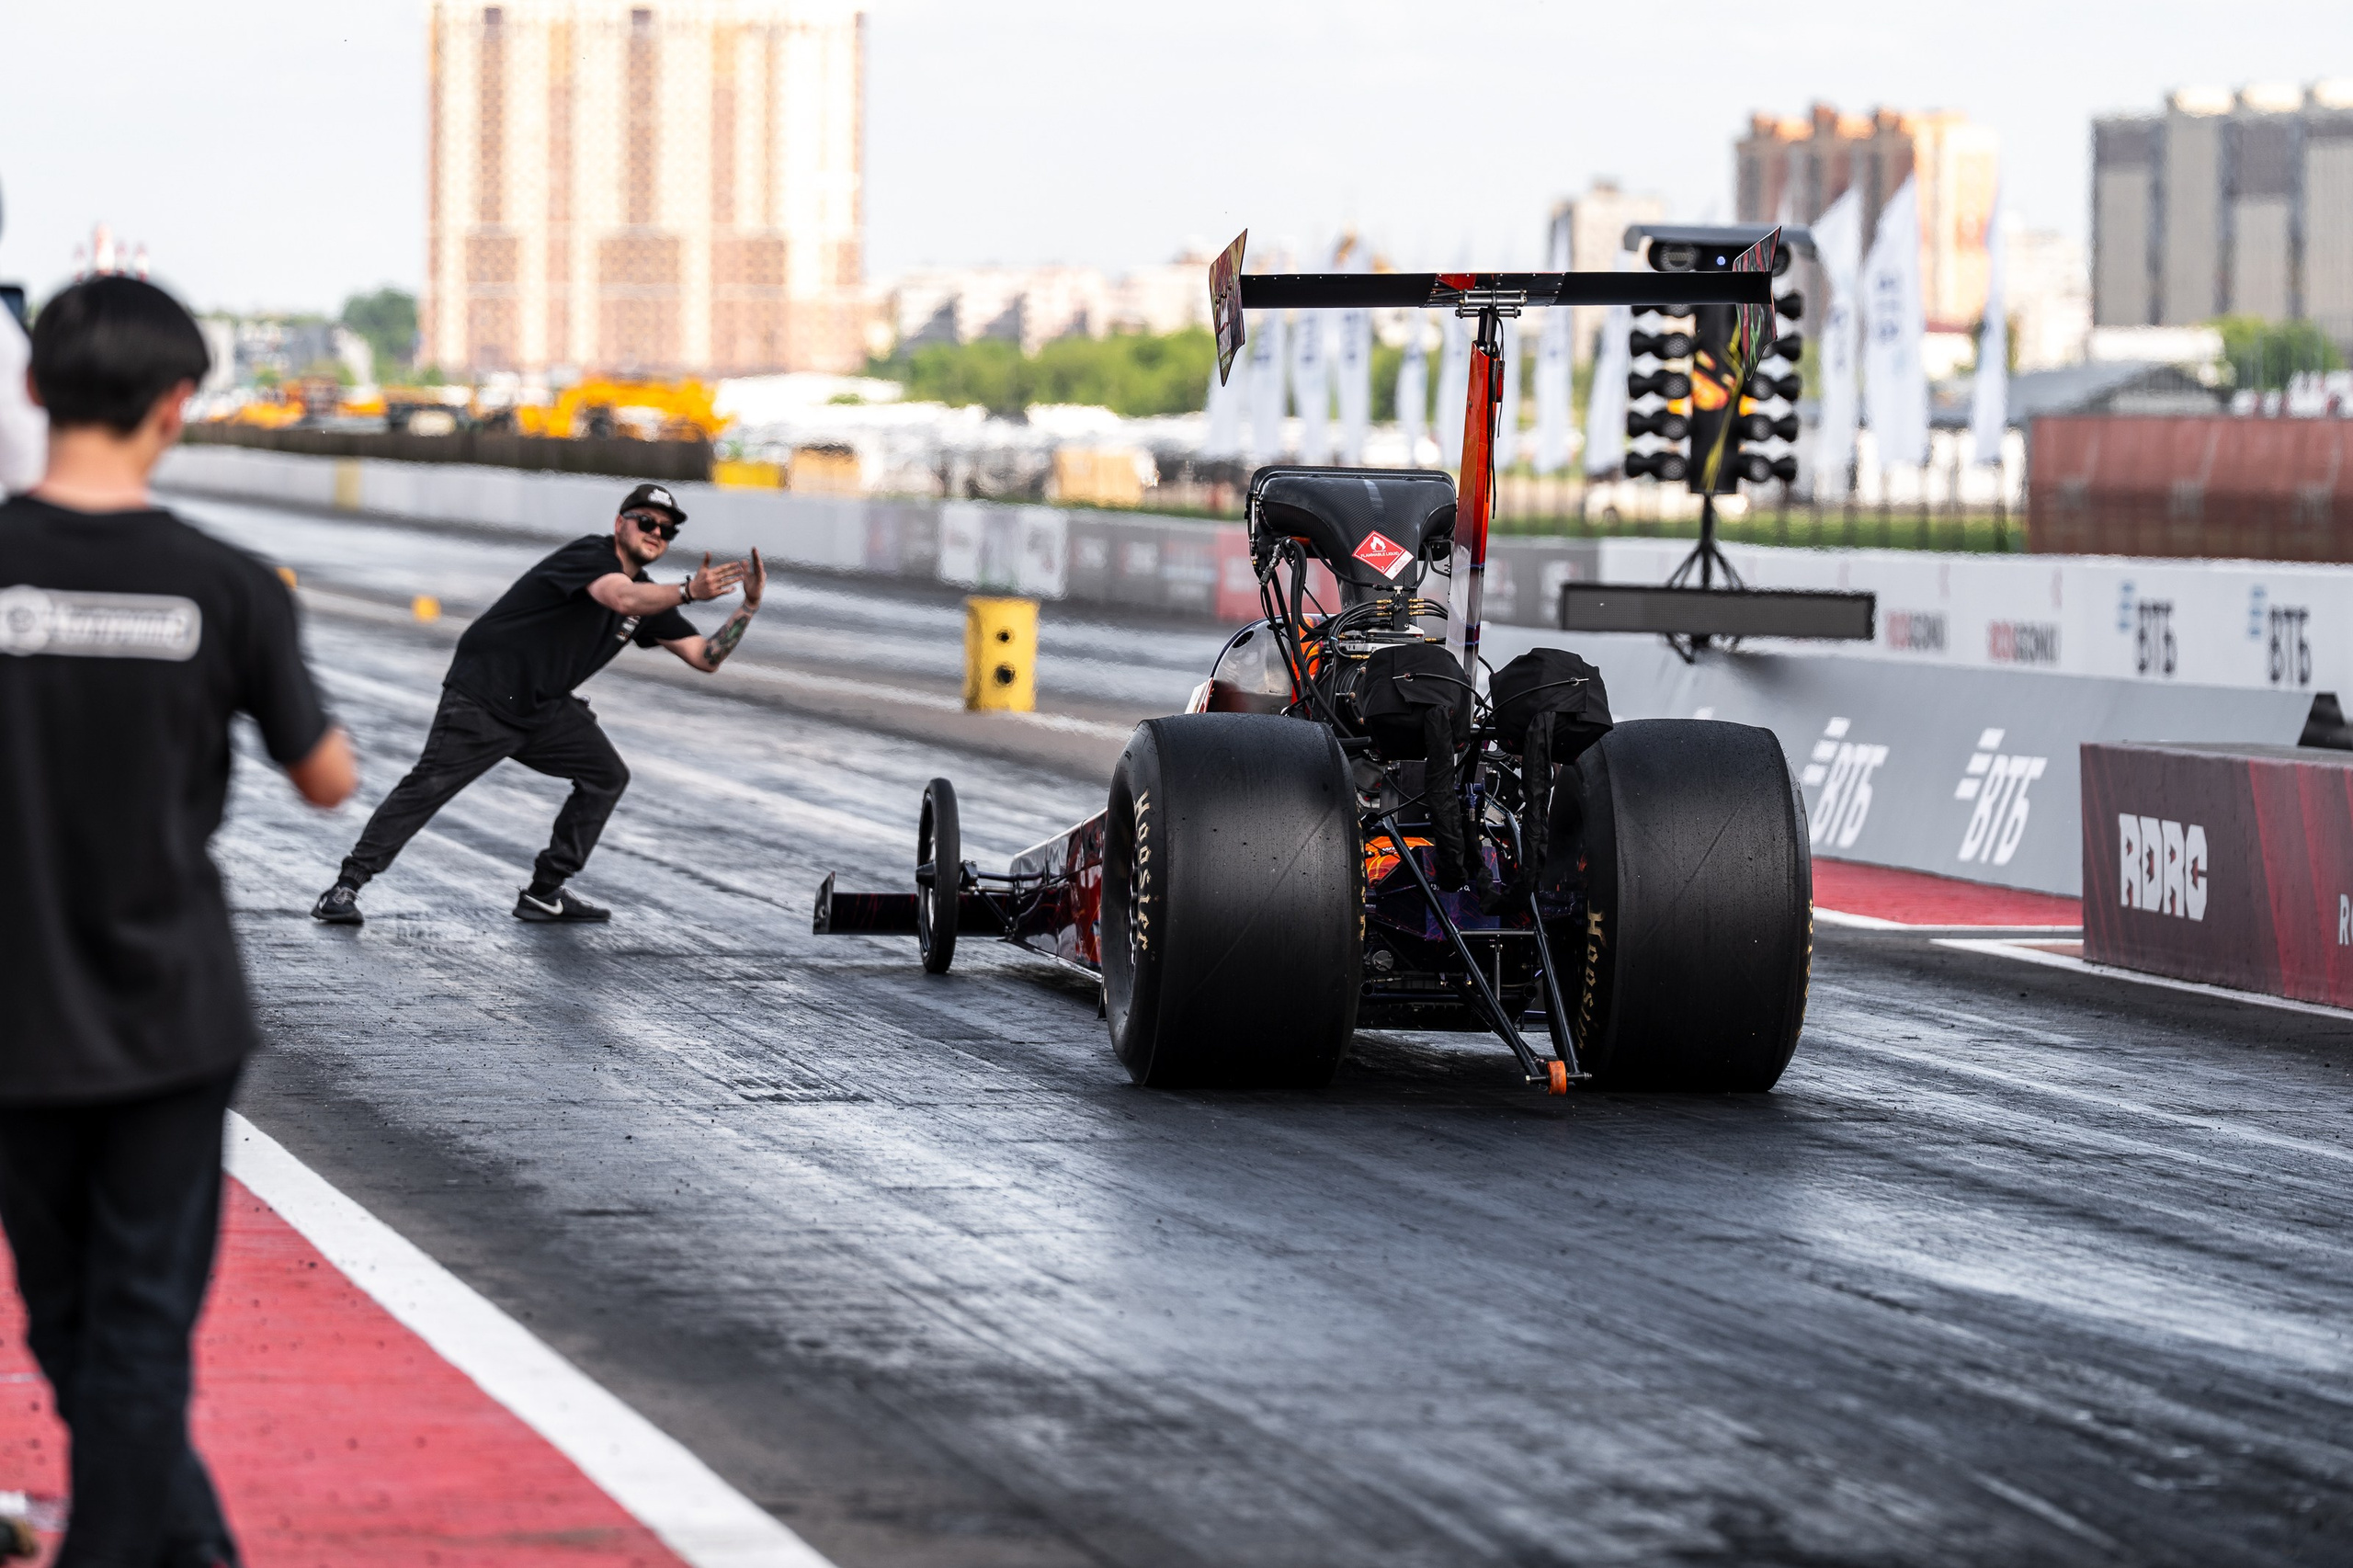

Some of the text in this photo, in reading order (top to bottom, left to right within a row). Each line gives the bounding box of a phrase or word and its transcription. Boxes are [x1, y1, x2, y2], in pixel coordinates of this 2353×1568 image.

[1810, 742, 1890, 849] ВТБ
[1957, 755, 2048, 867] ВТБ
[1133, 789, 1152, 951] Hoosier
[2119, 812, 2209, 923] RDRC
